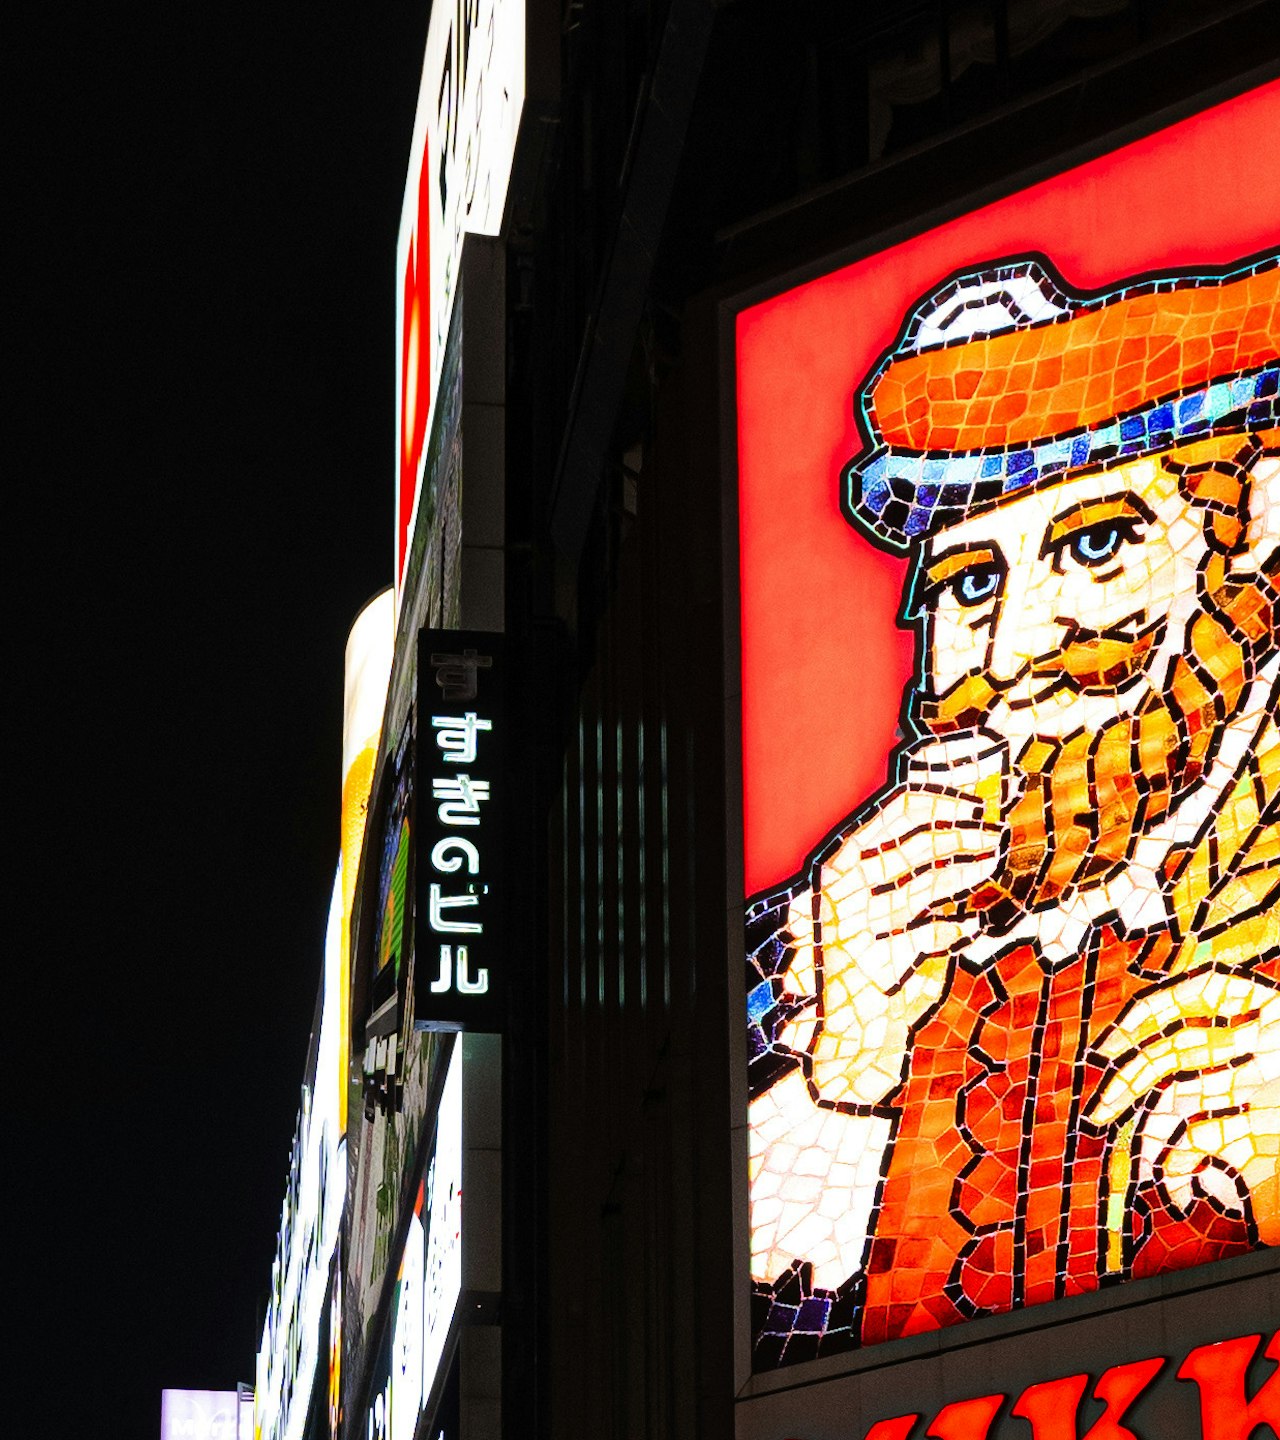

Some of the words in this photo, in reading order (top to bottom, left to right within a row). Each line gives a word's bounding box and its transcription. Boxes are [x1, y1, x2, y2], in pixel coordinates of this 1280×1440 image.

[430, 649, 493, 995] すすきのビル
